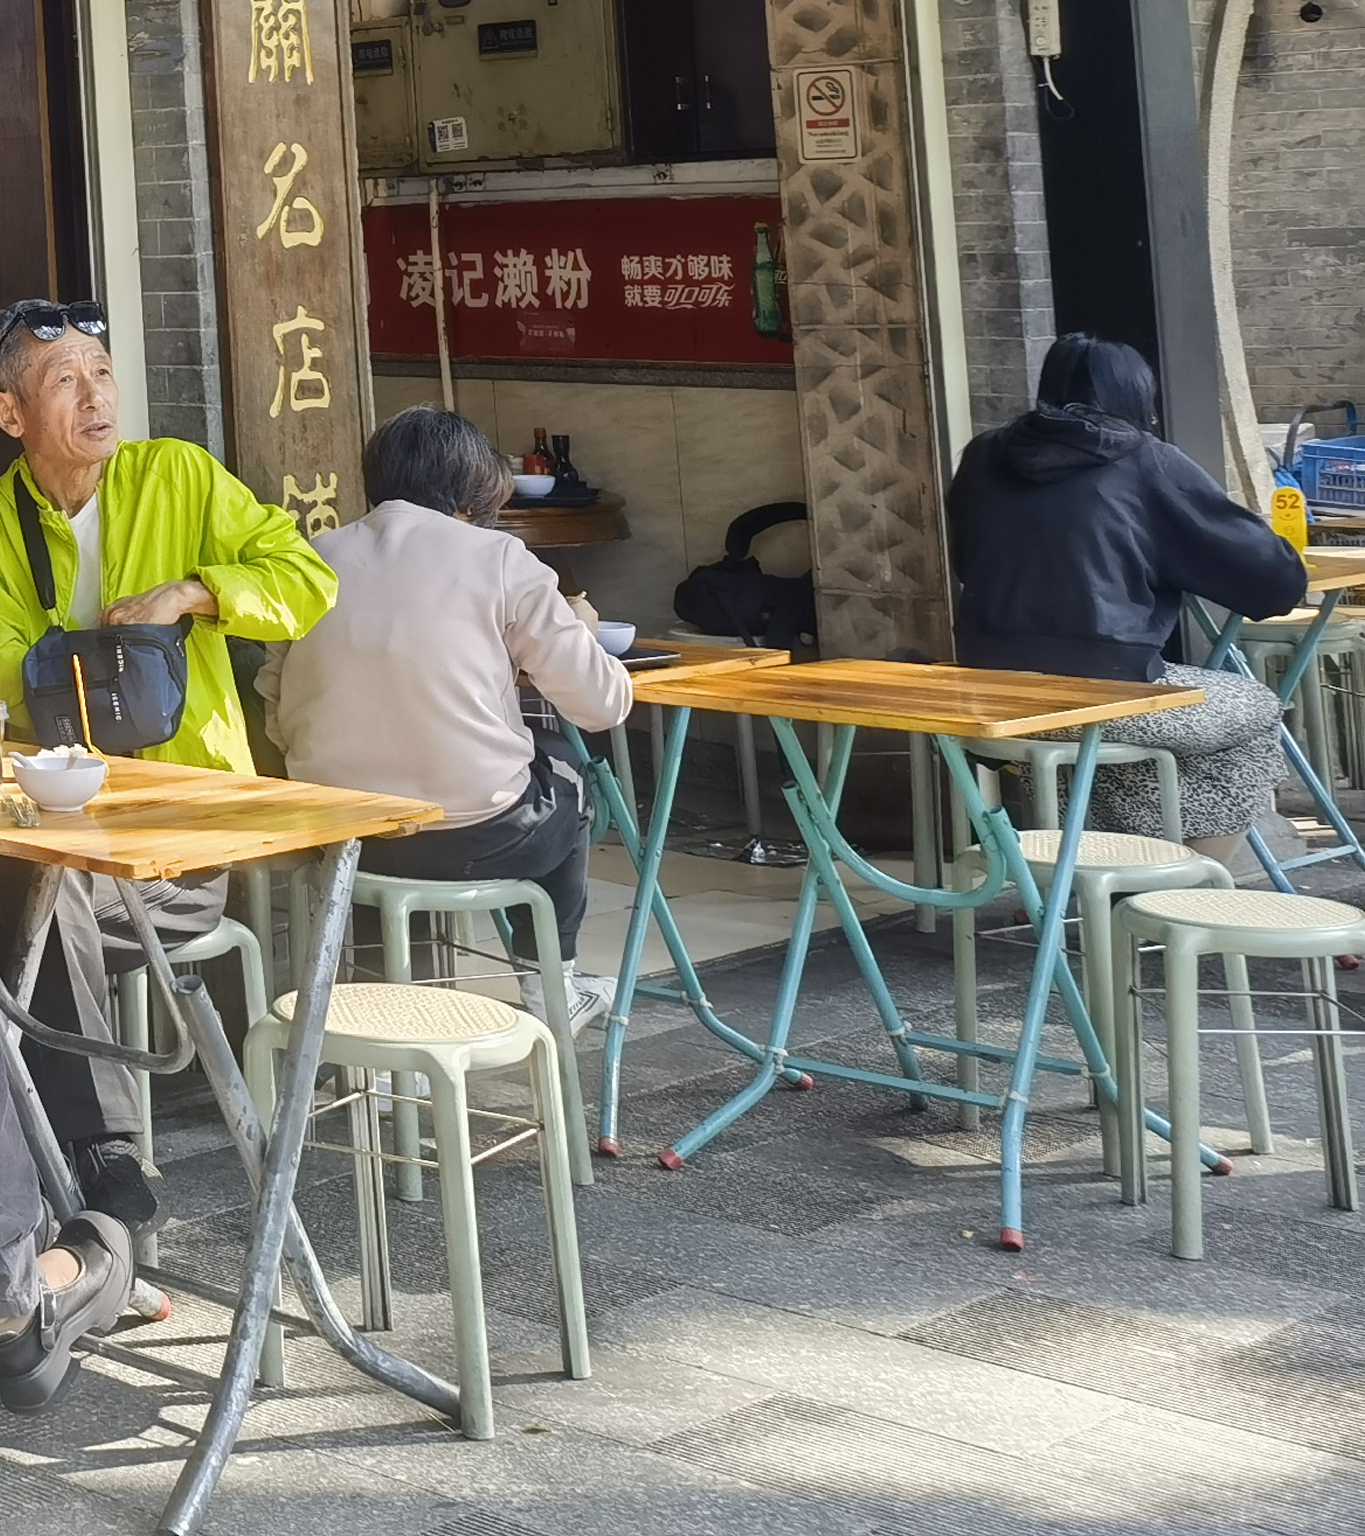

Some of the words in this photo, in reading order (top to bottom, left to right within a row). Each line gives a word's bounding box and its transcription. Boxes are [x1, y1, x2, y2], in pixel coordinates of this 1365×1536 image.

[396, 248, 592, 309] 凌记濑粉
[621, 254, 734, 281] 畅爽才够味
[624, 283, 736, 310] 就要可口可乐
[1275, 493, 1301, 510] 52
